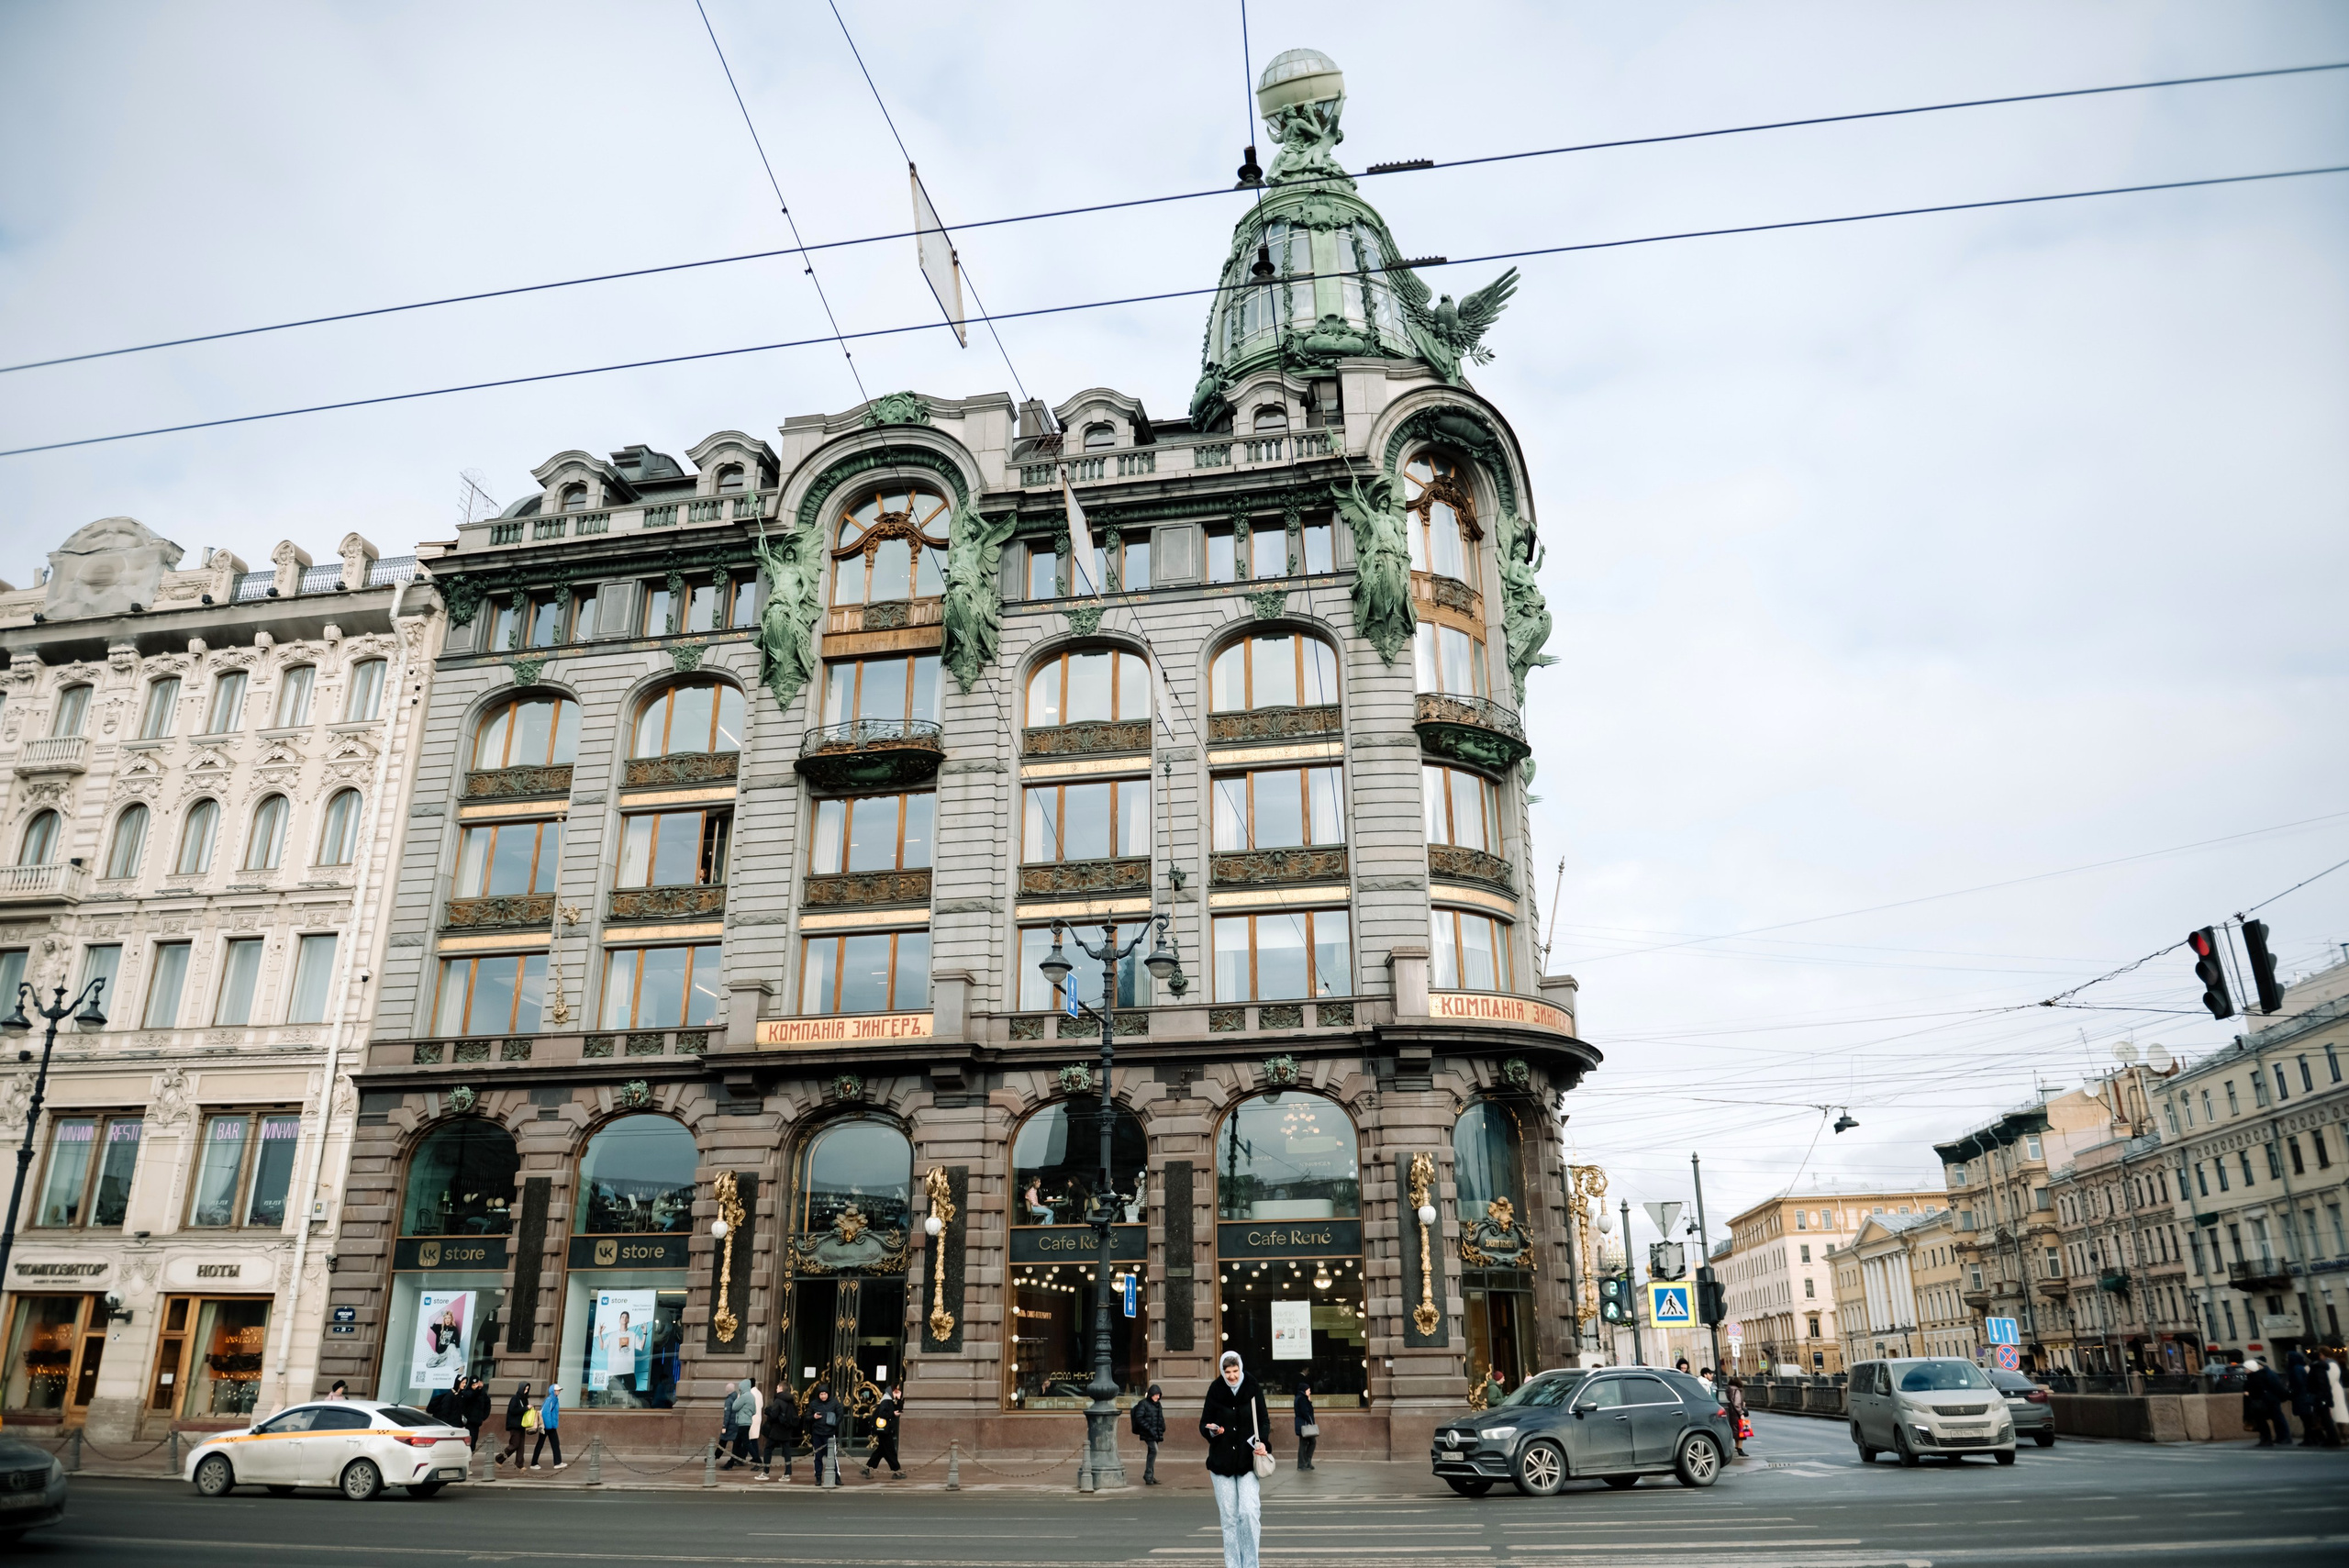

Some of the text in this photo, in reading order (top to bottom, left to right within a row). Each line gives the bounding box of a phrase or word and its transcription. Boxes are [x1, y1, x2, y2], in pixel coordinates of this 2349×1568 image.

[768, 1019, 844, 1042] КОМПАНІЯ
[217, 1122, 239, 1140] BAR
[1039, 1232, 1119, 1251] Cafe Reé
[1248, 1227, 1332, 1246] Cafe René
[444, 1247, 485, 1261] store
[621, 1244, 665, 1259] store
[196, 1264, 241, 1277] НОТЫ
[1609, 1281, 1618, 1295] 2
